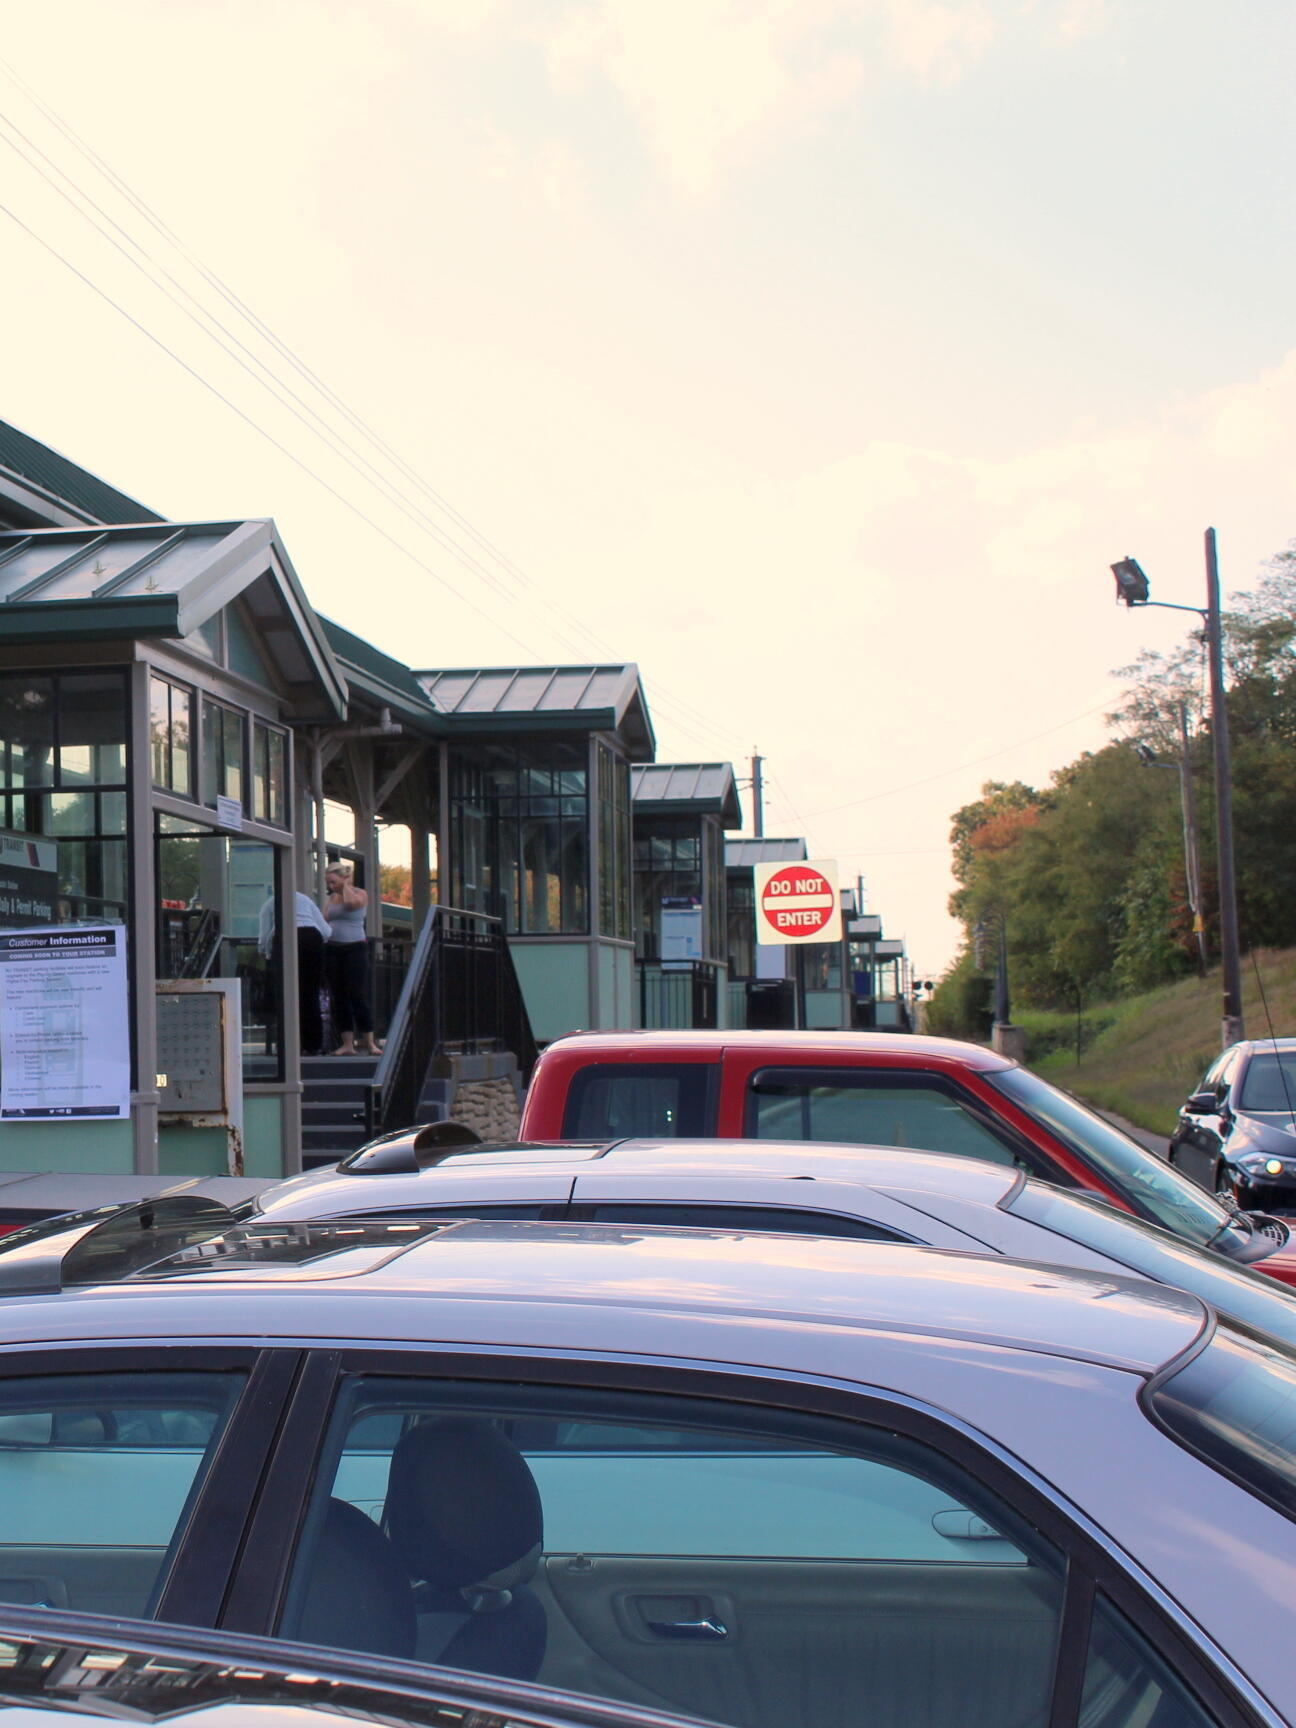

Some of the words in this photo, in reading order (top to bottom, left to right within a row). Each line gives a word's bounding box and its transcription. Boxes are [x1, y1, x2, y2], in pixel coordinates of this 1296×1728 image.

[770, 880, 791, 895] DO
[795, 878, 824, 894] NOT
[16, 898, 32, 915] Permit
[33, 900, 51, 921] Parking
[777, 911, 822, 927] ENTER
[8, 938, 48, 948] Customer
[49, 935, 107, 945] Information
